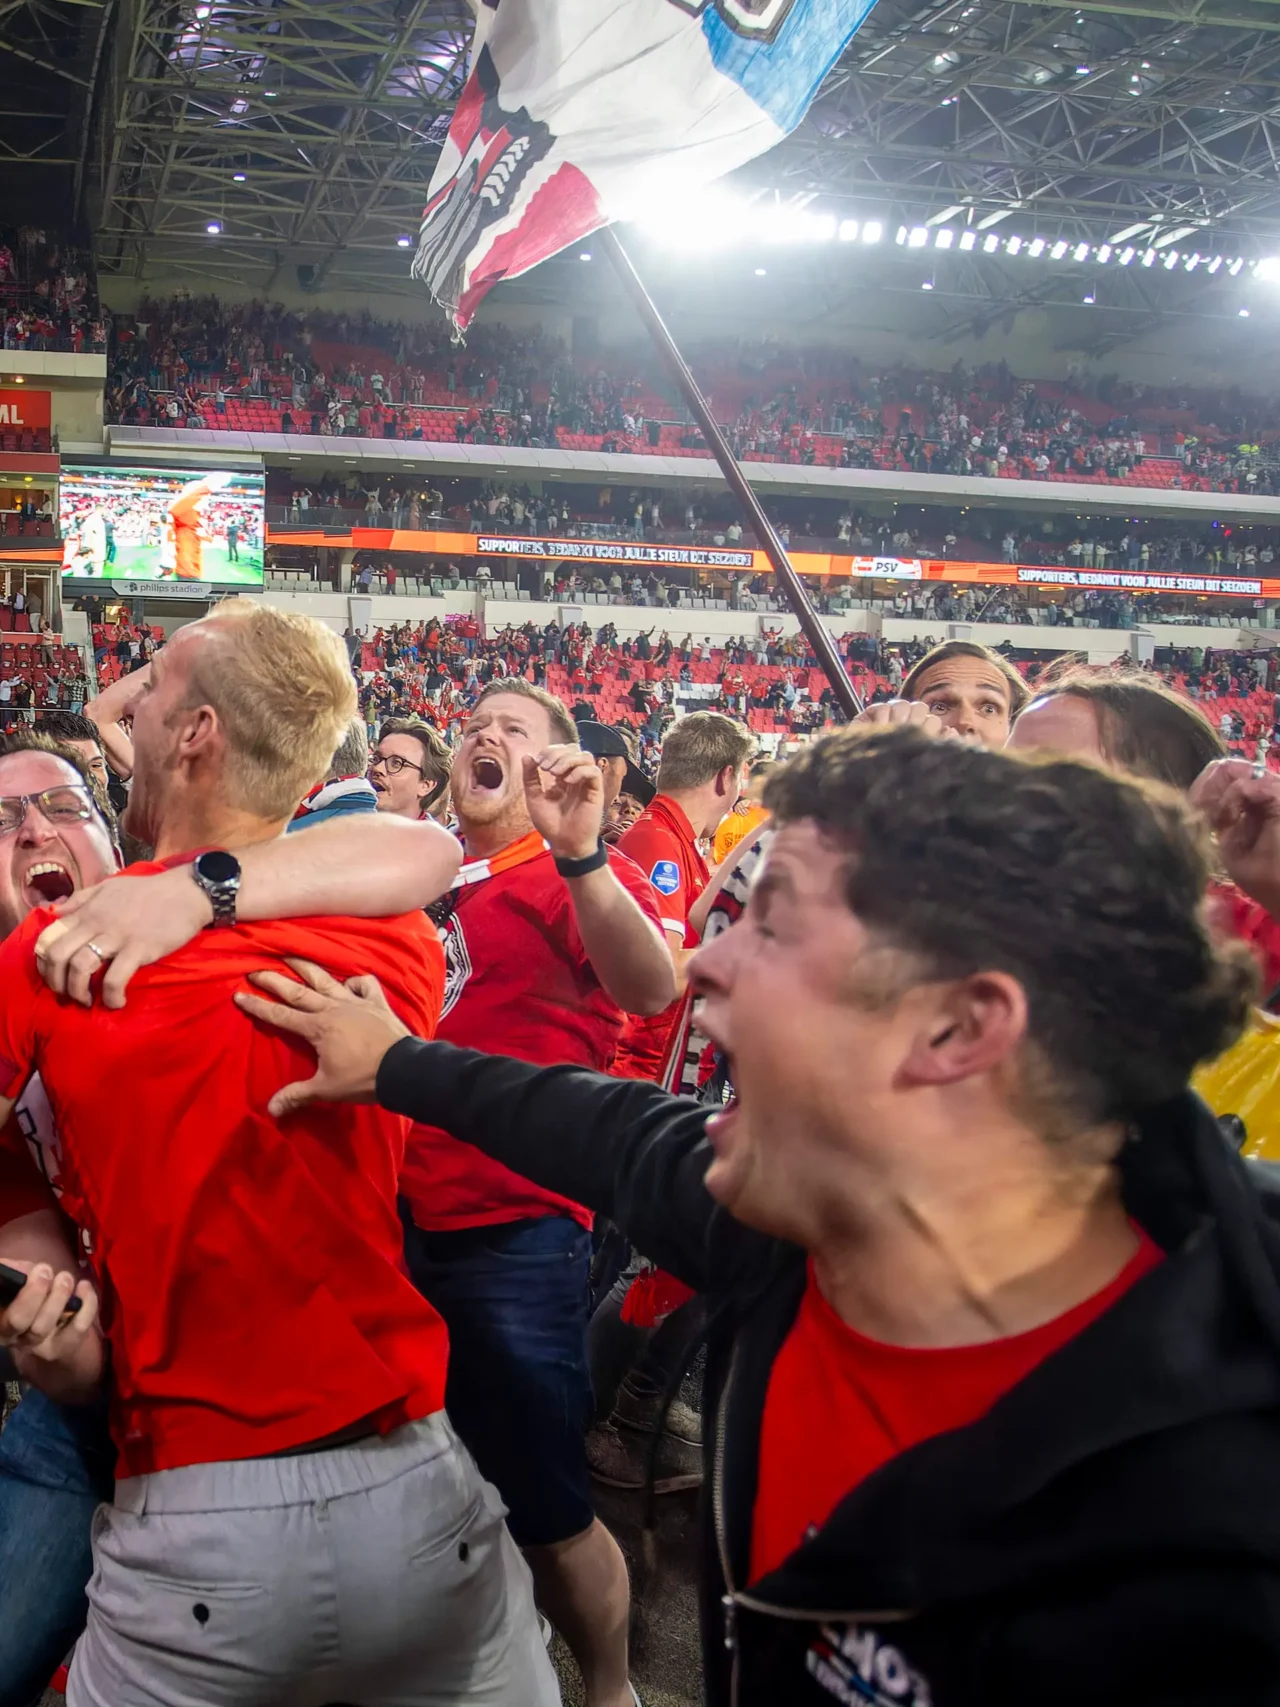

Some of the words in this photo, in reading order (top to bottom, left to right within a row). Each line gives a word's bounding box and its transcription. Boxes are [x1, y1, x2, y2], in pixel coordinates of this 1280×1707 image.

[875, 562, 899, 573] PSV
[140, 582, 169, 592] philips
[171, 584, 203, 593] stadion
